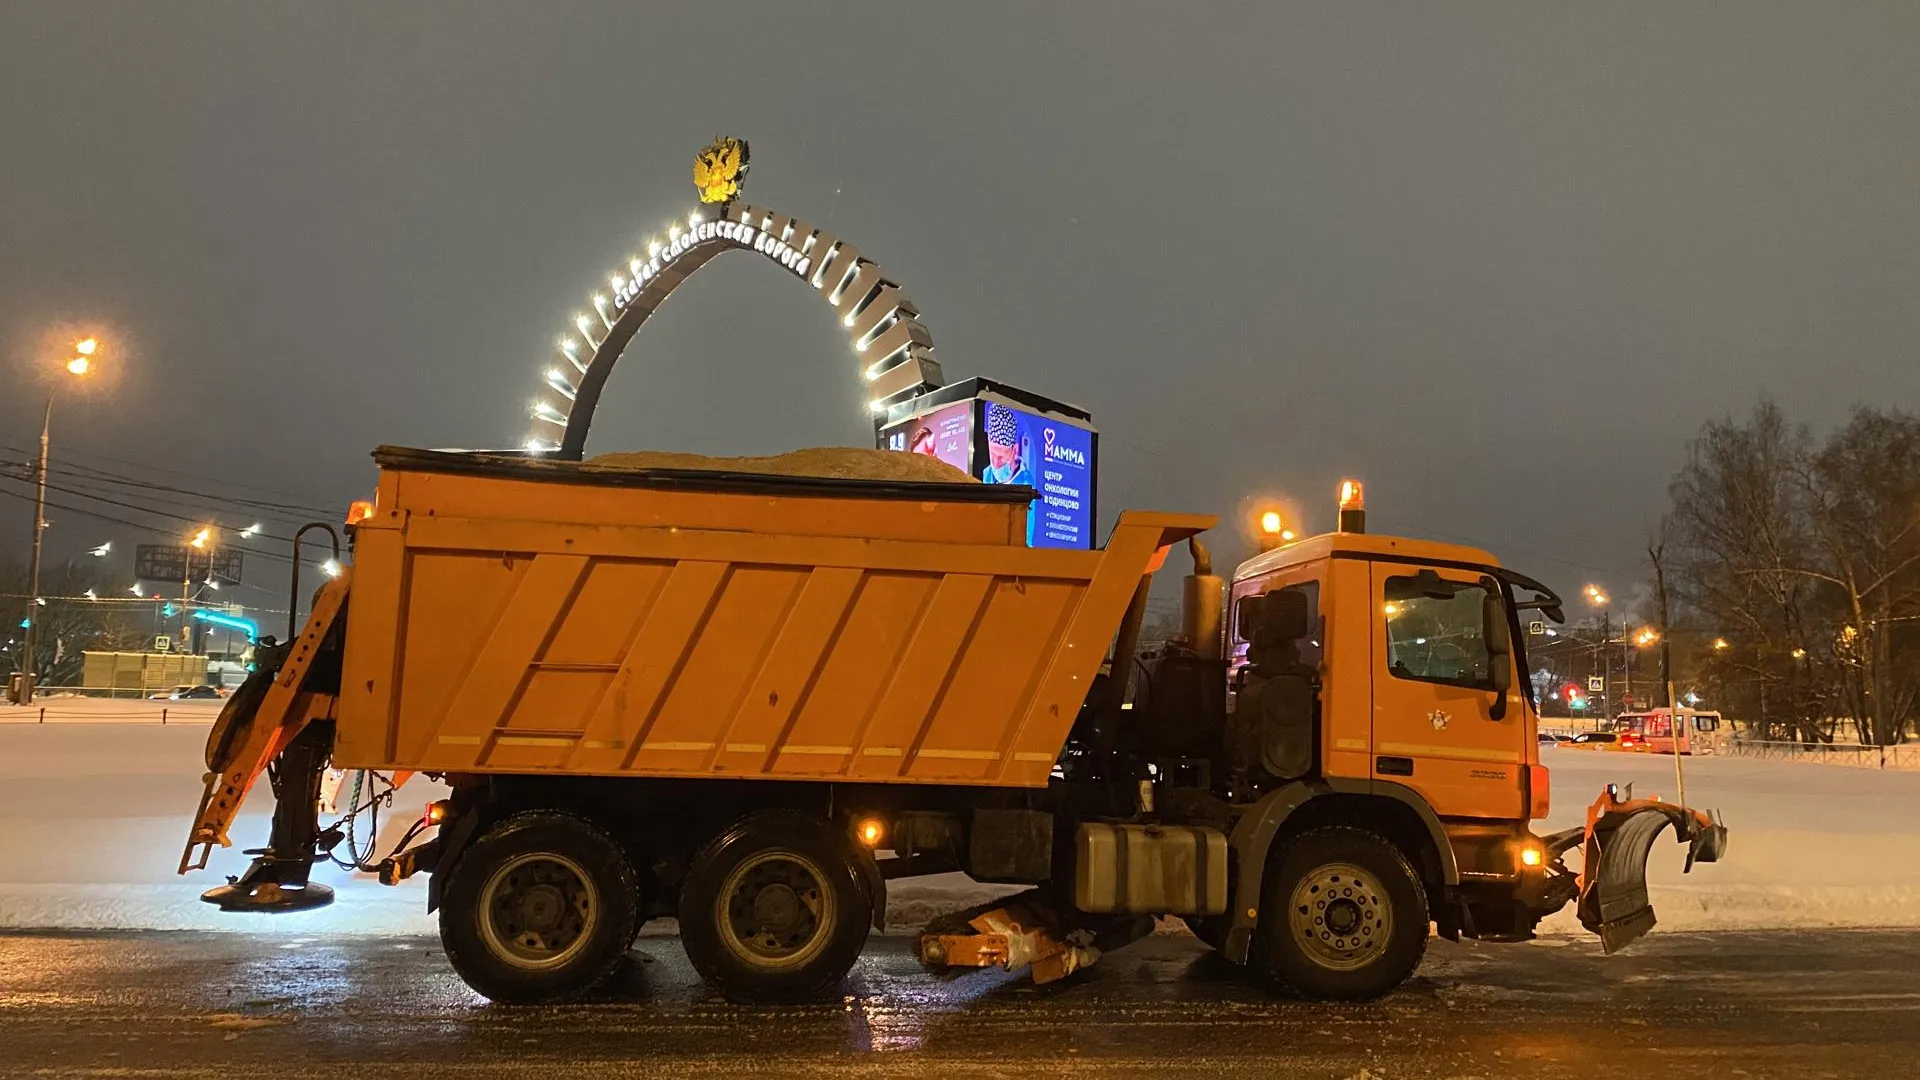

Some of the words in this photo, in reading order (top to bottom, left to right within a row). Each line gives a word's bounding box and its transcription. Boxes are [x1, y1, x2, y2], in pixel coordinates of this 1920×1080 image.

[754, 232, 811, 276] ДОРОГА
[1044, 470, 1063, 481] ЦЕНТР
[1044, 483, 1079, 498] ОНКОЛОГИИ
[1048, 496, 1079, 510] ОДИНЦОВО
